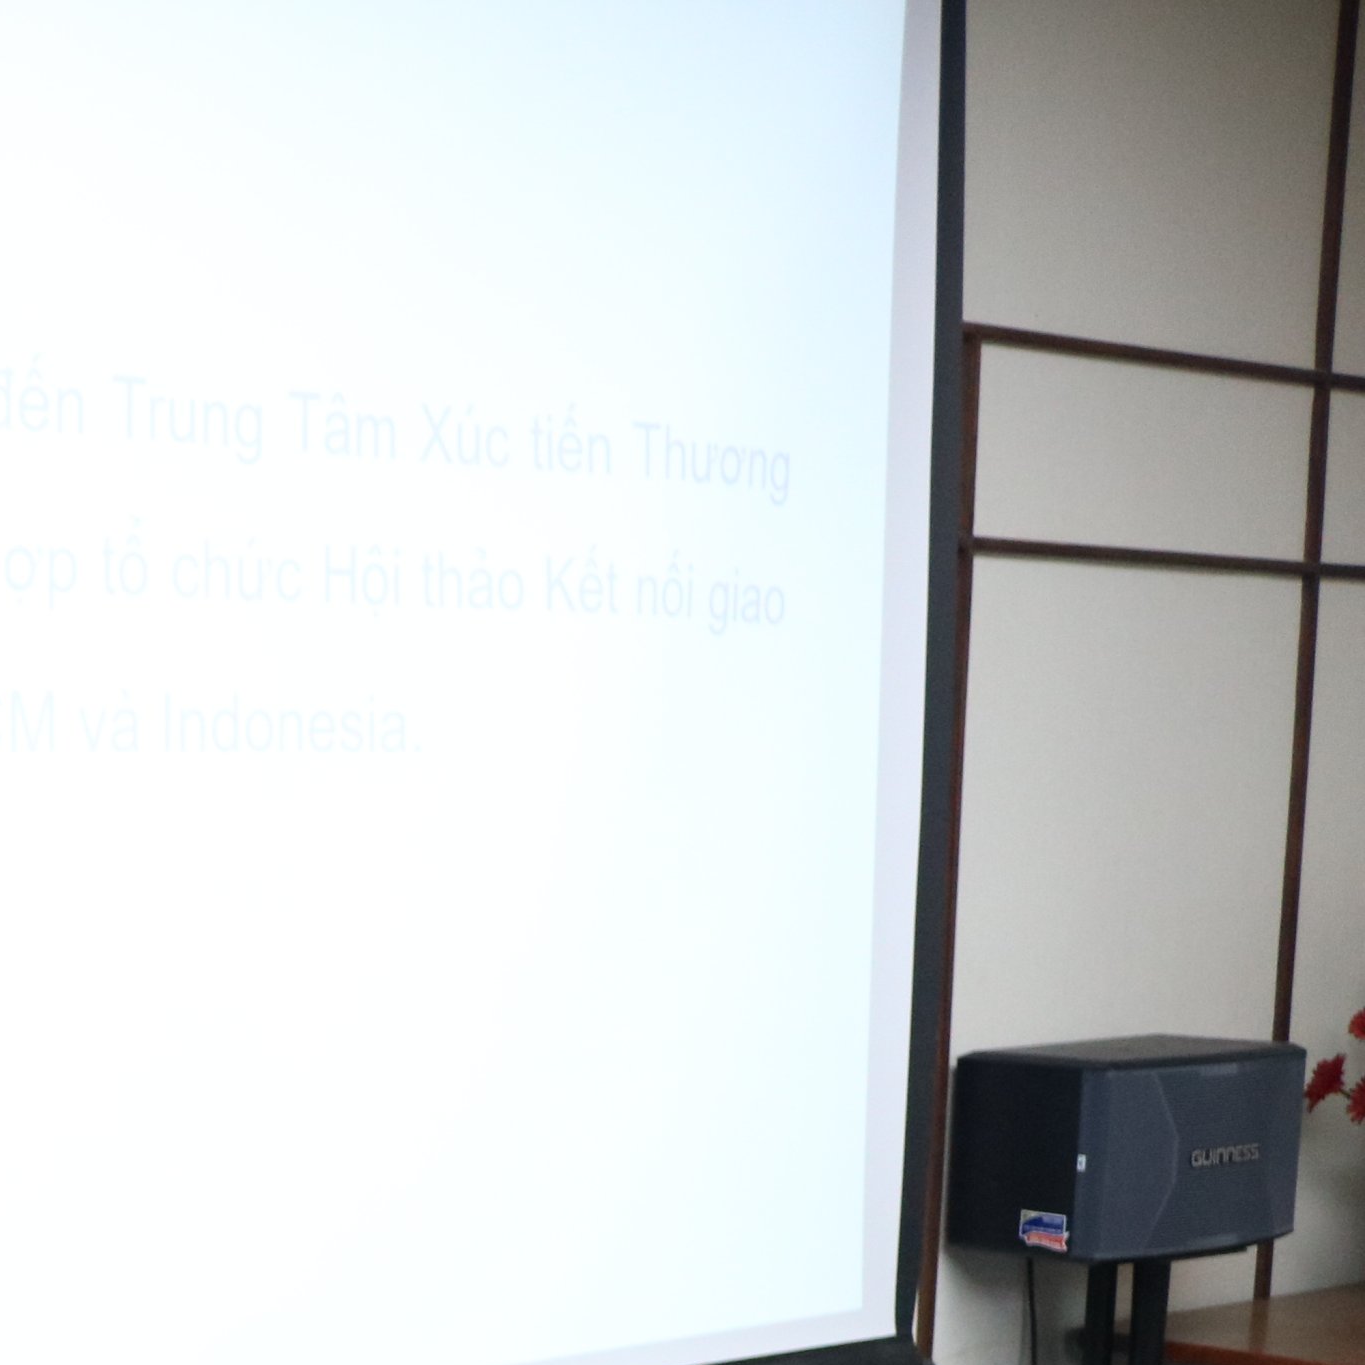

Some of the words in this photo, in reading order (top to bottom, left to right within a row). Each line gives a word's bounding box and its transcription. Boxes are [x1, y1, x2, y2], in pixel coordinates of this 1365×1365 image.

[112, 374, 263, 466] Trung
[287, 390, 397, 461] Tâm
[419, 402, 510, 470] Xúc
[529, 401, 614, 476] tiến
[630, 419, 791, 509] Thương
[102, 516, 149, 597] tổ
[171, 538, 302, 604] chức
[324, 544, 402, 621] Hội
[421, 547, 525, 611] thảo
[544, 543, 620, 616] Kết
[634, 547, 695, 620] nối
[707, 571, 787, 639] giao
[79, 689, 139, 752] và
[164, 692, 422, 753] Indonesia.
[1191, 1143, 1260, 1168] GUINNESS
